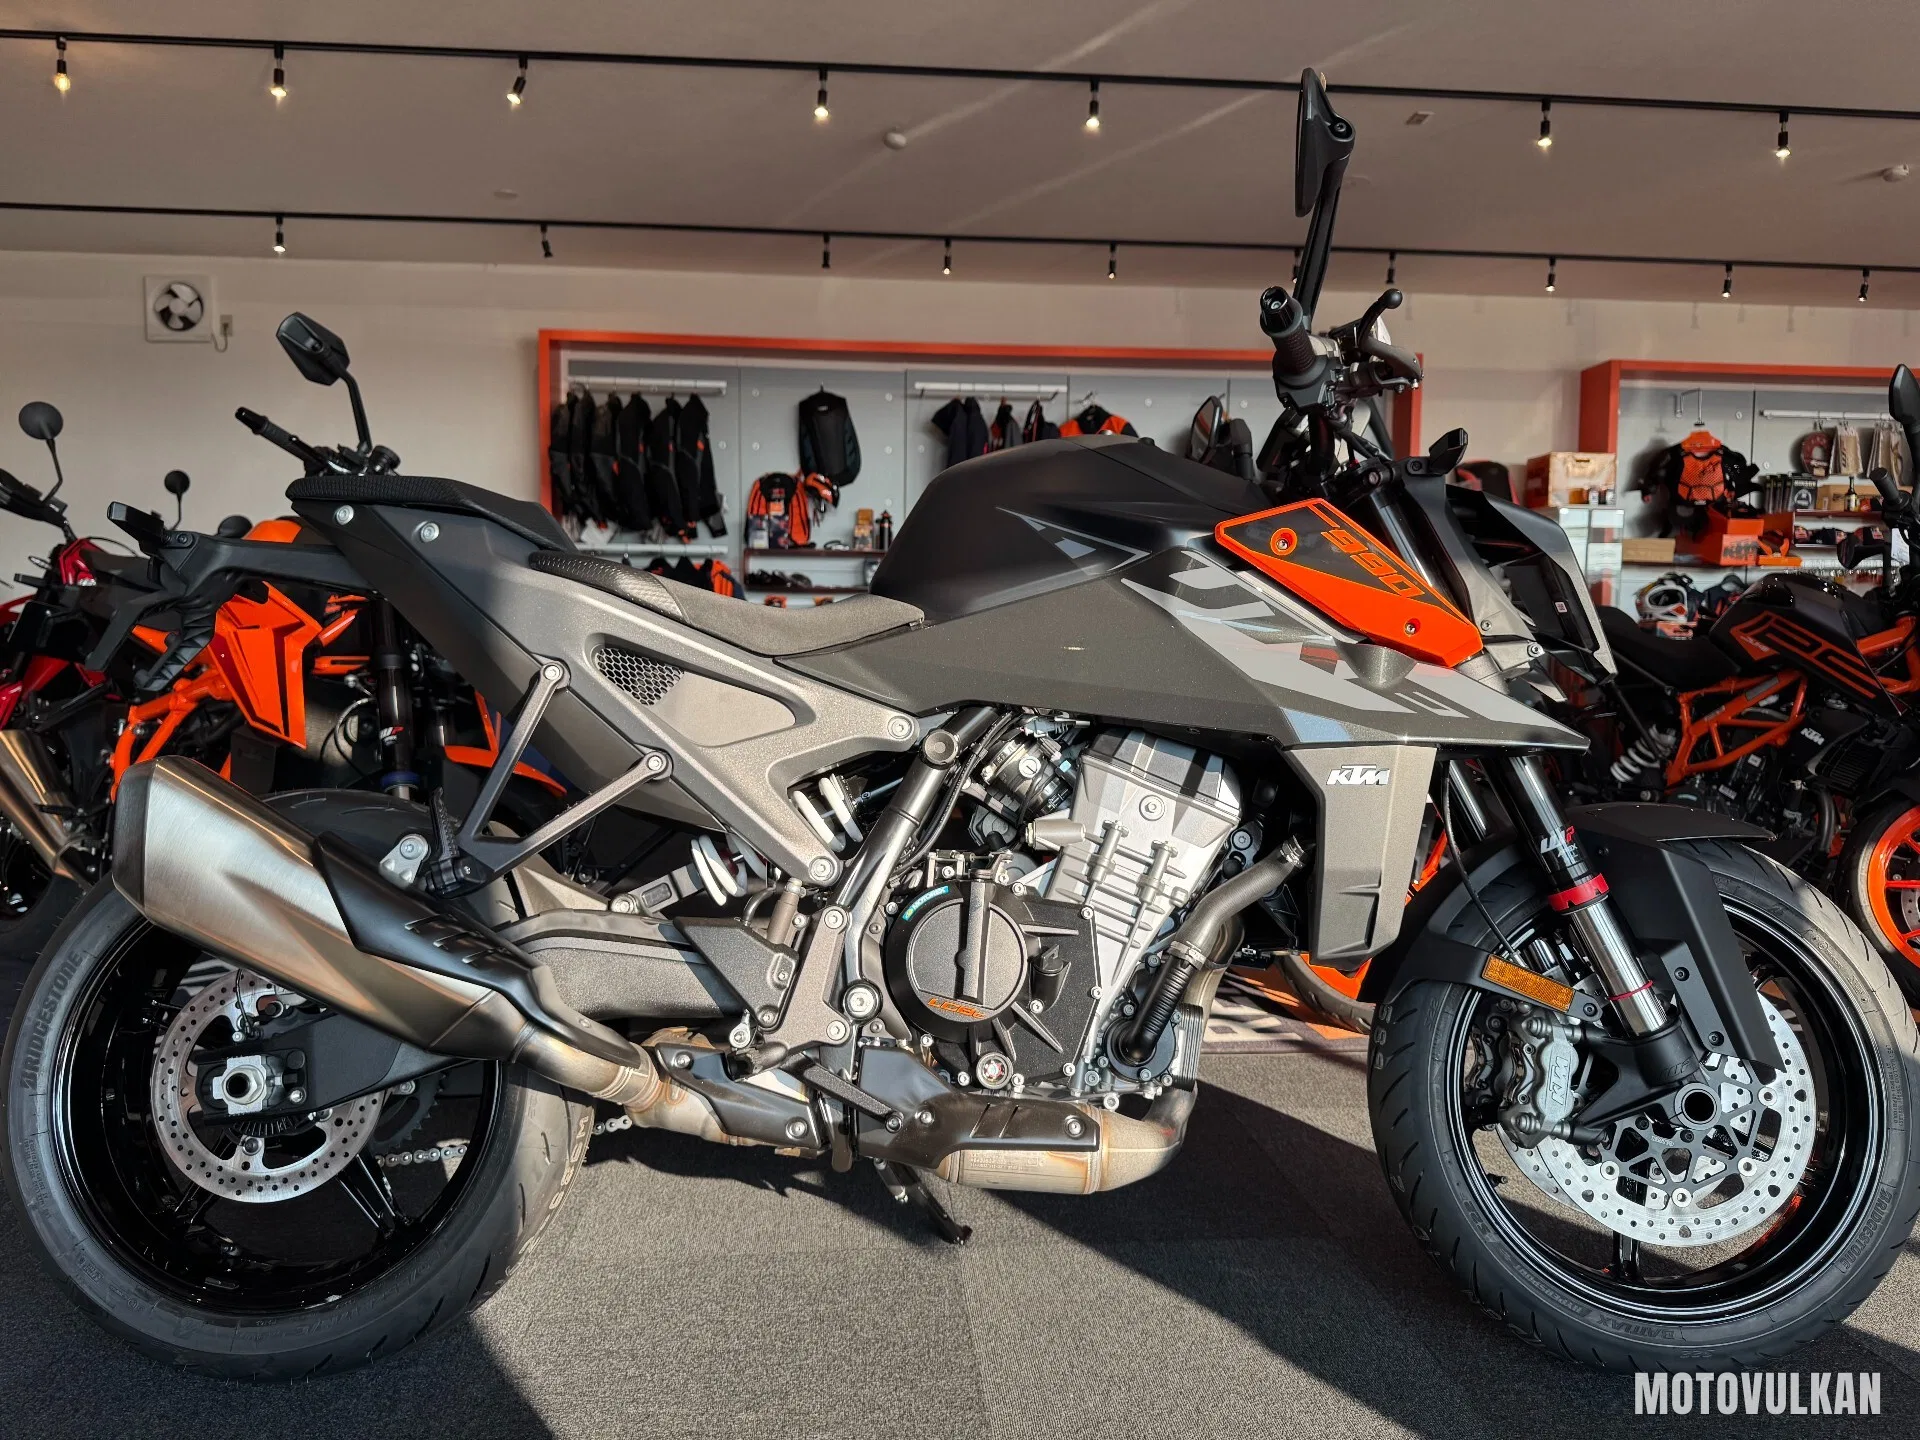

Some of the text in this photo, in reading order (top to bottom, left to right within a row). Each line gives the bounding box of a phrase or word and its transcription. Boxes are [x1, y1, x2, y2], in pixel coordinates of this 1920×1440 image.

[1321, 529, 1425, 599] 990
[1326, 764, 1391, 786] KTM
[20, 951, 84, 1091] BRIDGESTONE
[1548, 1055, 1569, 1106] KTM
[1842, 1186, 1894, 1270] BRIDGESTONE
